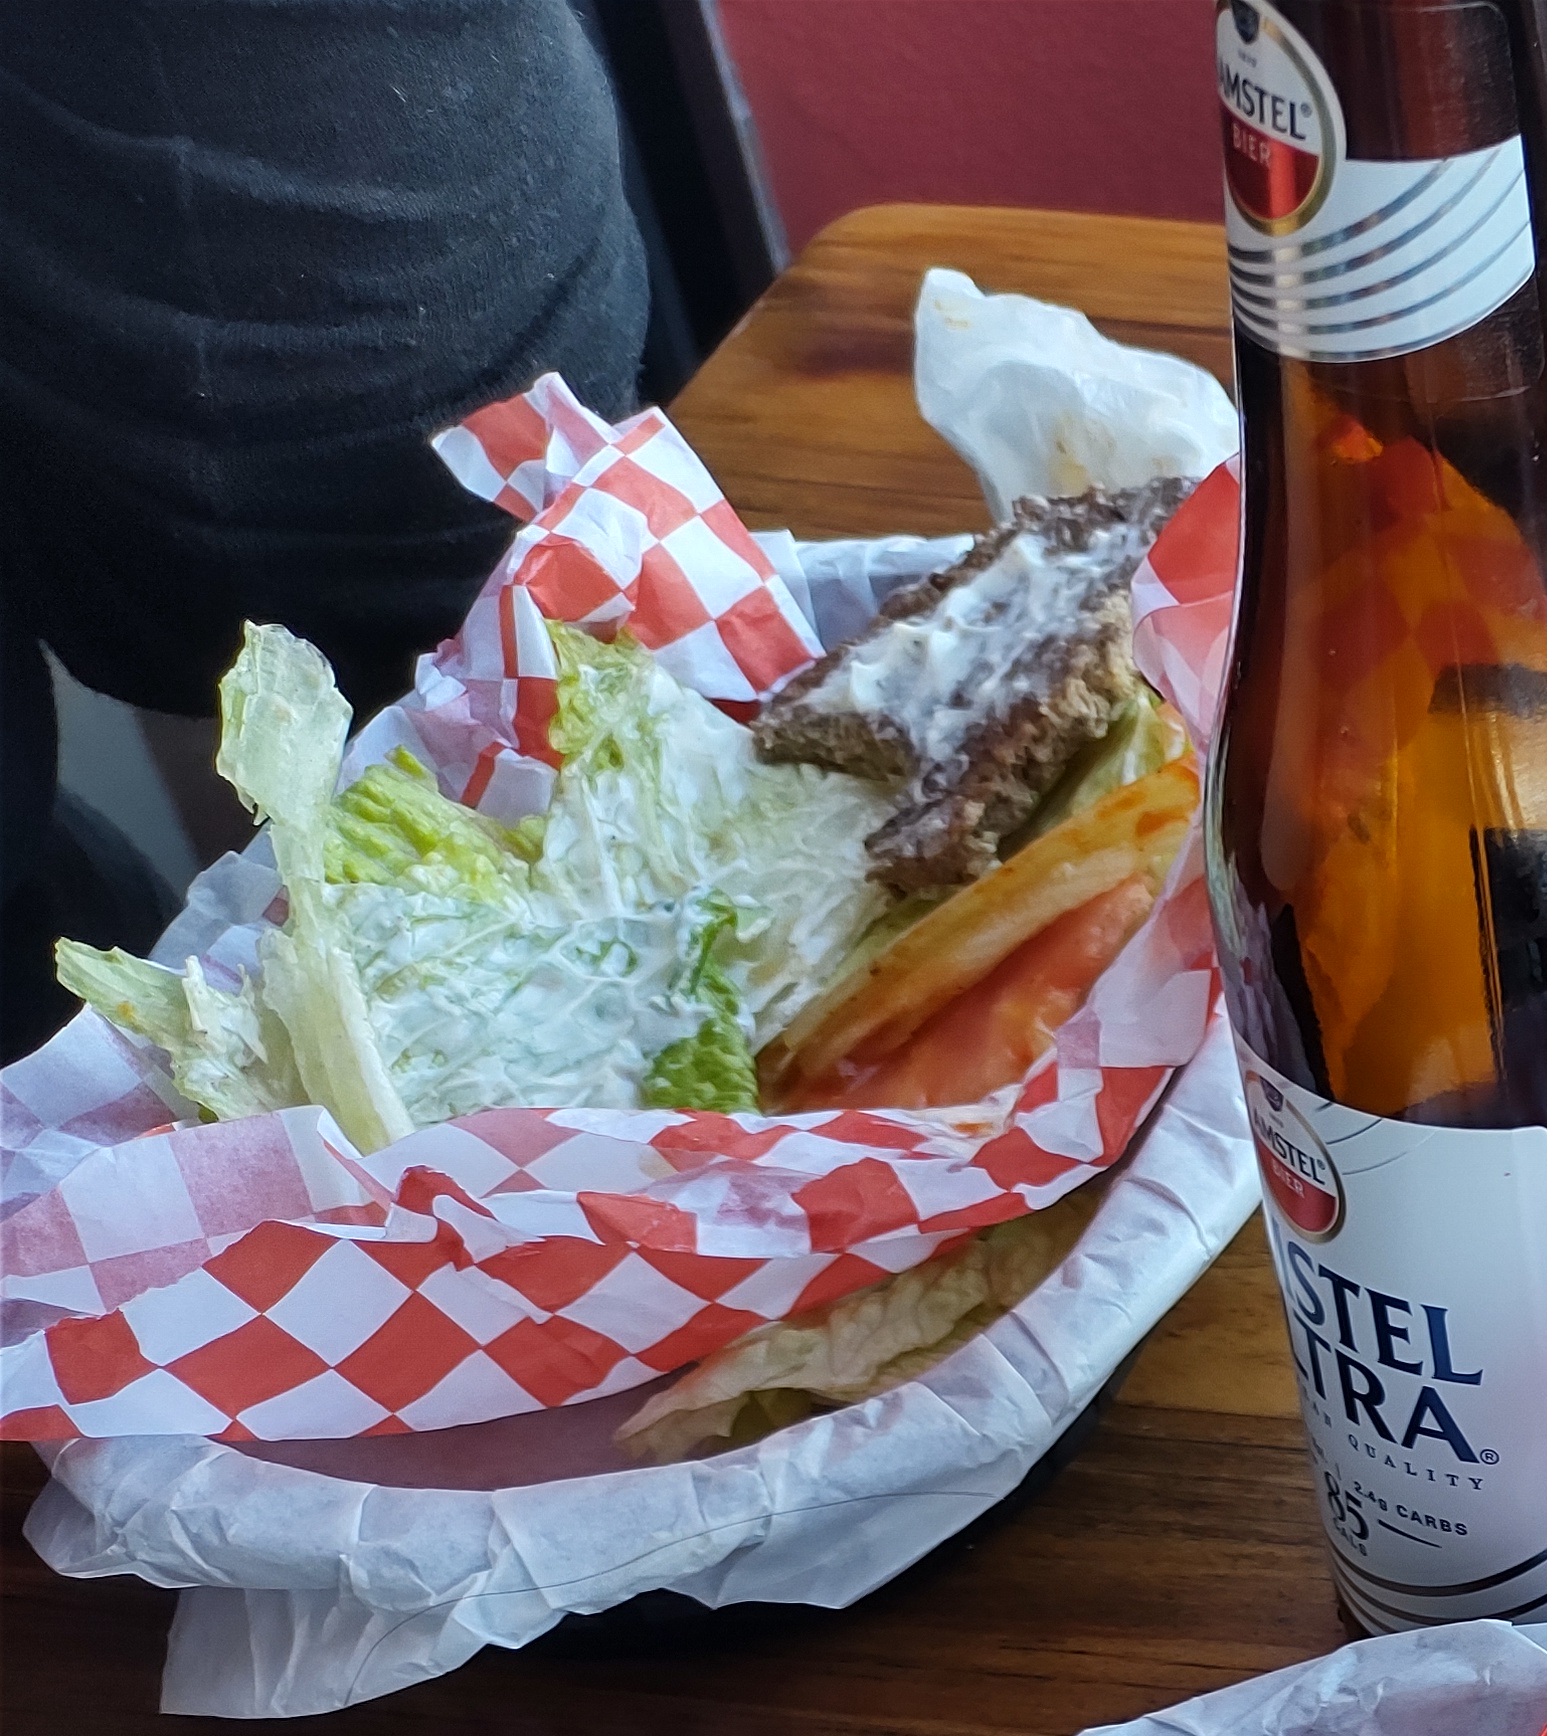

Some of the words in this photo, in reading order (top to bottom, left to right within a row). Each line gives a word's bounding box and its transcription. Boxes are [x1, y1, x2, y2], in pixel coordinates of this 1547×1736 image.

[1232, 122, 1271, 168] BIER
[1272, 1216, 1484, 1387] STEL
[1347, 1433, 1484, 1491] QUALITY
[1323, 1470, 1370, 1541] 85
[1396, 1504, 1469, 1536] CARBS
